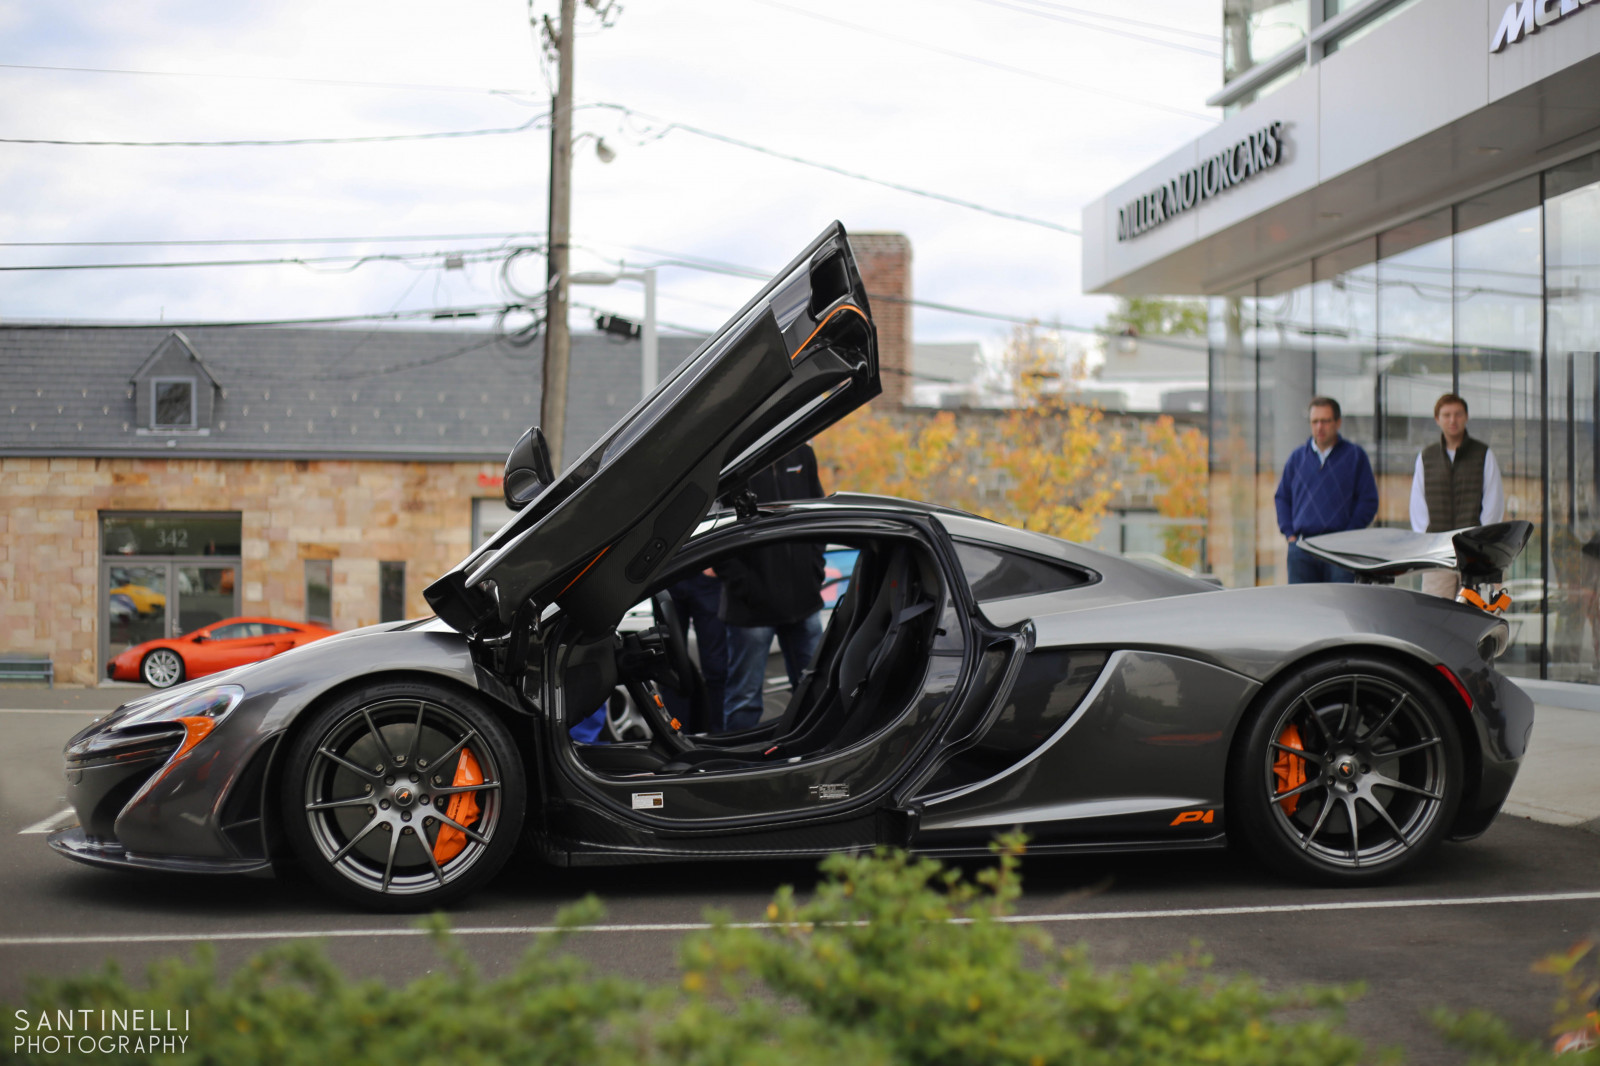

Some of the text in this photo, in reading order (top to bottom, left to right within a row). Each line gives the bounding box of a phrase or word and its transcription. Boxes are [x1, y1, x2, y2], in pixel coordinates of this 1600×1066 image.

[1117, 121, 1283, 243] MILLER MOTORCARS
[155, 528, 188, 549] 342
[1168, 809, 1215, 827] P1
